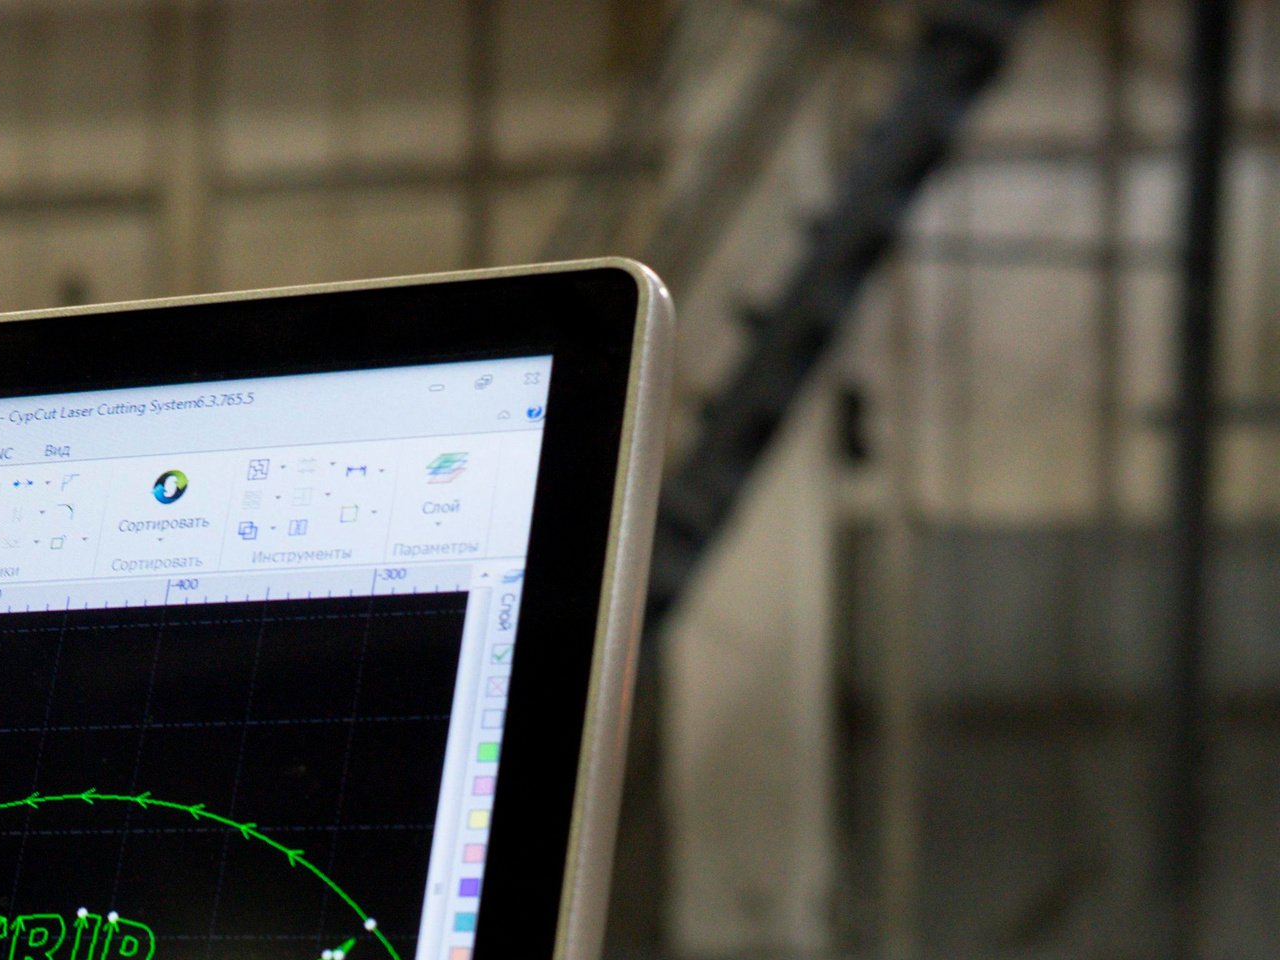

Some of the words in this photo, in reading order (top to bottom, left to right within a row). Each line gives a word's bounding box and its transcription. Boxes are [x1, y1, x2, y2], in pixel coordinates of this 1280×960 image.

[9, 408, 57, 426] CypCut
[61, 405, 93, 420] Laser
[97, 401, 146, 417] Cutting
[149, 391, 254, 414] System6.3.765.5
[44, 443, 71, 460] Вид
[422, 498, 461, 516] Слой
[117, 515, 210, 535] Сортировать
[251, 547, 353, 565] Инструменты
[392, 539, 480, 559] Параметры
[110, 555, 203, 573] Сортировать
[497, 593, 516, 632] Слой
